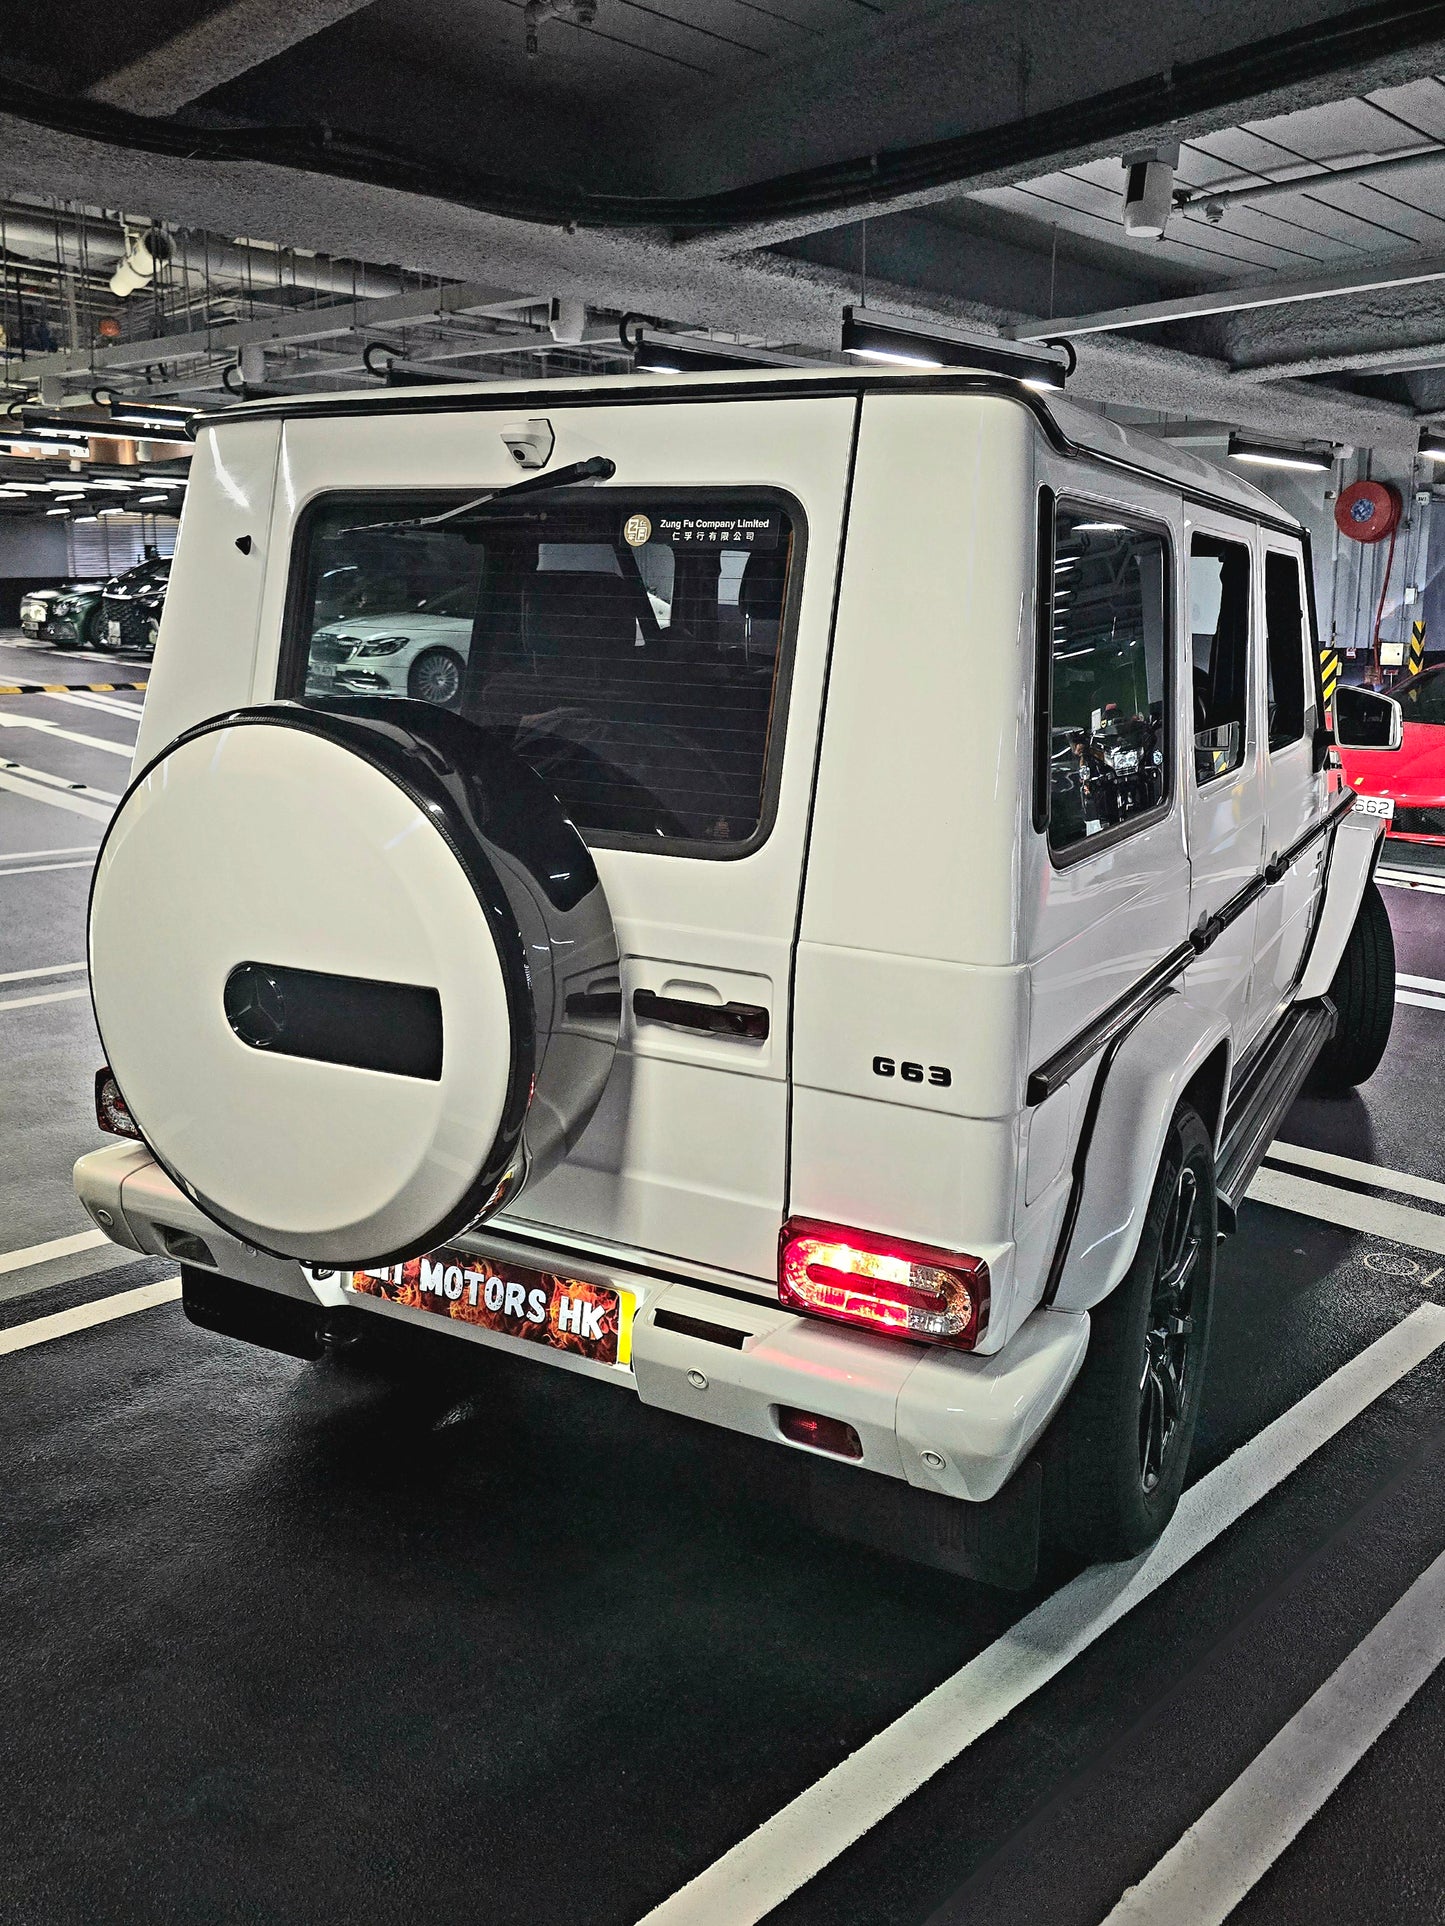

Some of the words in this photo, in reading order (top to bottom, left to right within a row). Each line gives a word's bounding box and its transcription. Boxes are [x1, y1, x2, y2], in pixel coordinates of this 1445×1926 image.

[660, 520, 681, 530] Zung
[683, 520, 694, 528] Fu
[696, 519, 736, 530] Company
[737, 519, 770, 528] Limited
[672, 531, 755, 541] 仁孚行有限公司
[872, 1056, 952, 1088] G63
[419, 1258, 547, 1324] MOTORS
[558, 1296, 606, 1341] HK
